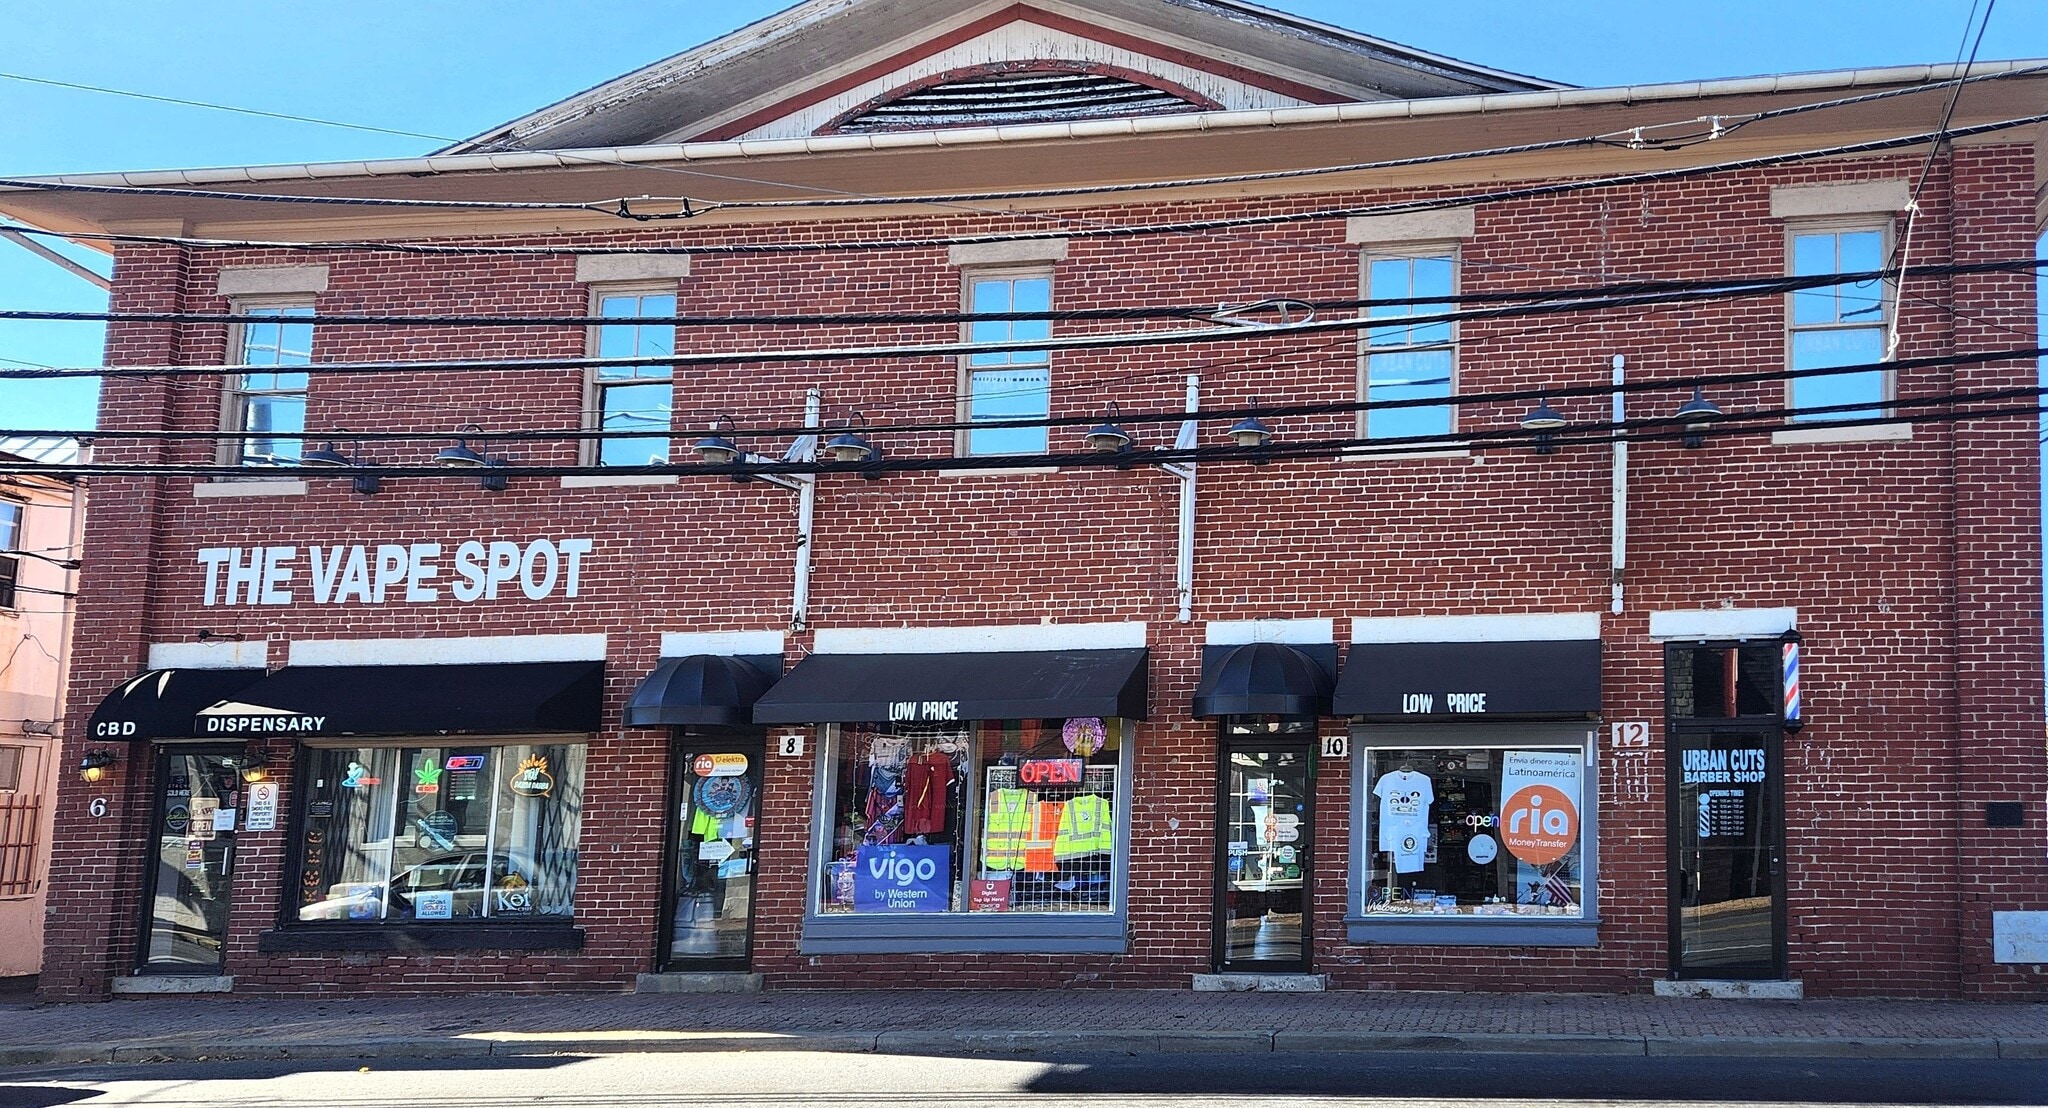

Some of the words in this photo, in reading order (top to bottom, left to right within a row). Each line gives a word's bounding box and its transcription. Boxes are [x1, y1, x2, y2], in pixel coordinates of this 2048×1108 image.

[199, 545, 297, 606] THE
[309, 543, 442, 604] VAPE
[452, 538, 593, 603] SPOT
[889, 702, 917, 721] LOW
[922, 701, 959, 720] PRICE
[1402, 693, 1433, 713] LOW
[1447, 693, 1487, 713] PRICE
[96, 721, 136, 736] CBD
[207, 716, 326, 732] DISPENSARY
[1617, 724, 1644, 746] 12
[785, 737, 796, 754] 8
[1326, 737, 1344, 756] 10
[449, 759, 480, 768] OPEN
[695, 757, 712, 769] ria
[1530, 757, 1552, 765] dinero
[1682, 749, 1727, 771] URBAN
[1730, 748, 1765, 771] CUTS
[1021, 762, 1079, 783] OPEN
[1508, 767, 1576, 778] Latinoamérica
[1684, 771, 1731, 783] BARBER
[1733, 771, 1766, 783] SHOP
[89, 797, 108, 818] 6
[1509, 795, 1569, 836] ria
[1465, 814, 1500, 833] open
[1508, 837, 1537, 848] Money
[1536, 838, 1567, 848] Transfer
[869, 850, 936, 886] vigo
[497, 887, 530, 911] Koi
[874, 889, 885, 901] by
[887, 888, 928, 899] Western
[1367, 885, 1414, 901] OPEN
[887, 898, 916, 908] Union
